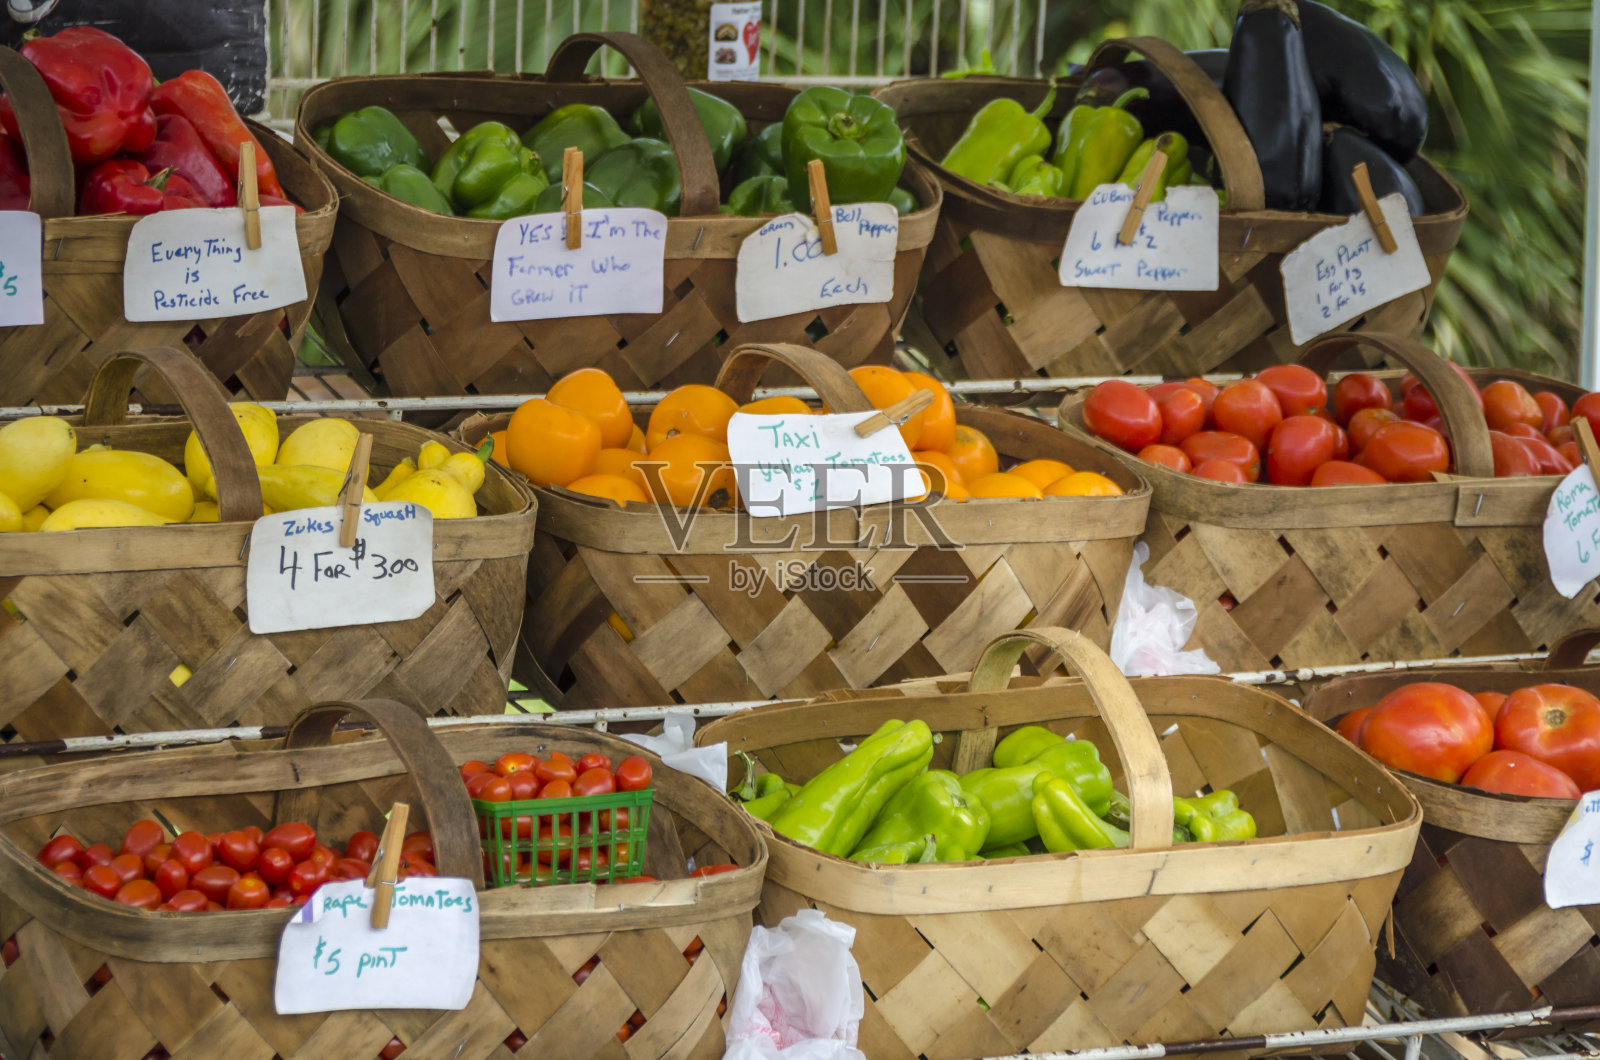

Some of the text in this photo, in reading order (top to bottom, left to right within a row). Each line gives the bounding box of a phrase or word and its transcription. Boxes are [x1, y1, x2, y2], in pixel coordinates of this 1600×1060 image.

[835, 207, 862, 224] Bell
[520, 223, 553, 245] YES
[585, 214, 626, 239] I'm
[632, 220, 661, 240] The
[1091, 231, 1102, 251] 6
[184, 267, 200, 285] is
[591, 255, 631, 275] Who
[232, 284, 270, 305] Free
[820, 276, 868, 299] Each
[1321, 305, 1332, 319] 2
[1556, 481, 1592, 514] Roma
[1576, 539, 1591, 565] 6
[279, 545, 303, 591] 4
[348, 537, 419, 581] $3.00
[312, 935, 343, 977] $5
